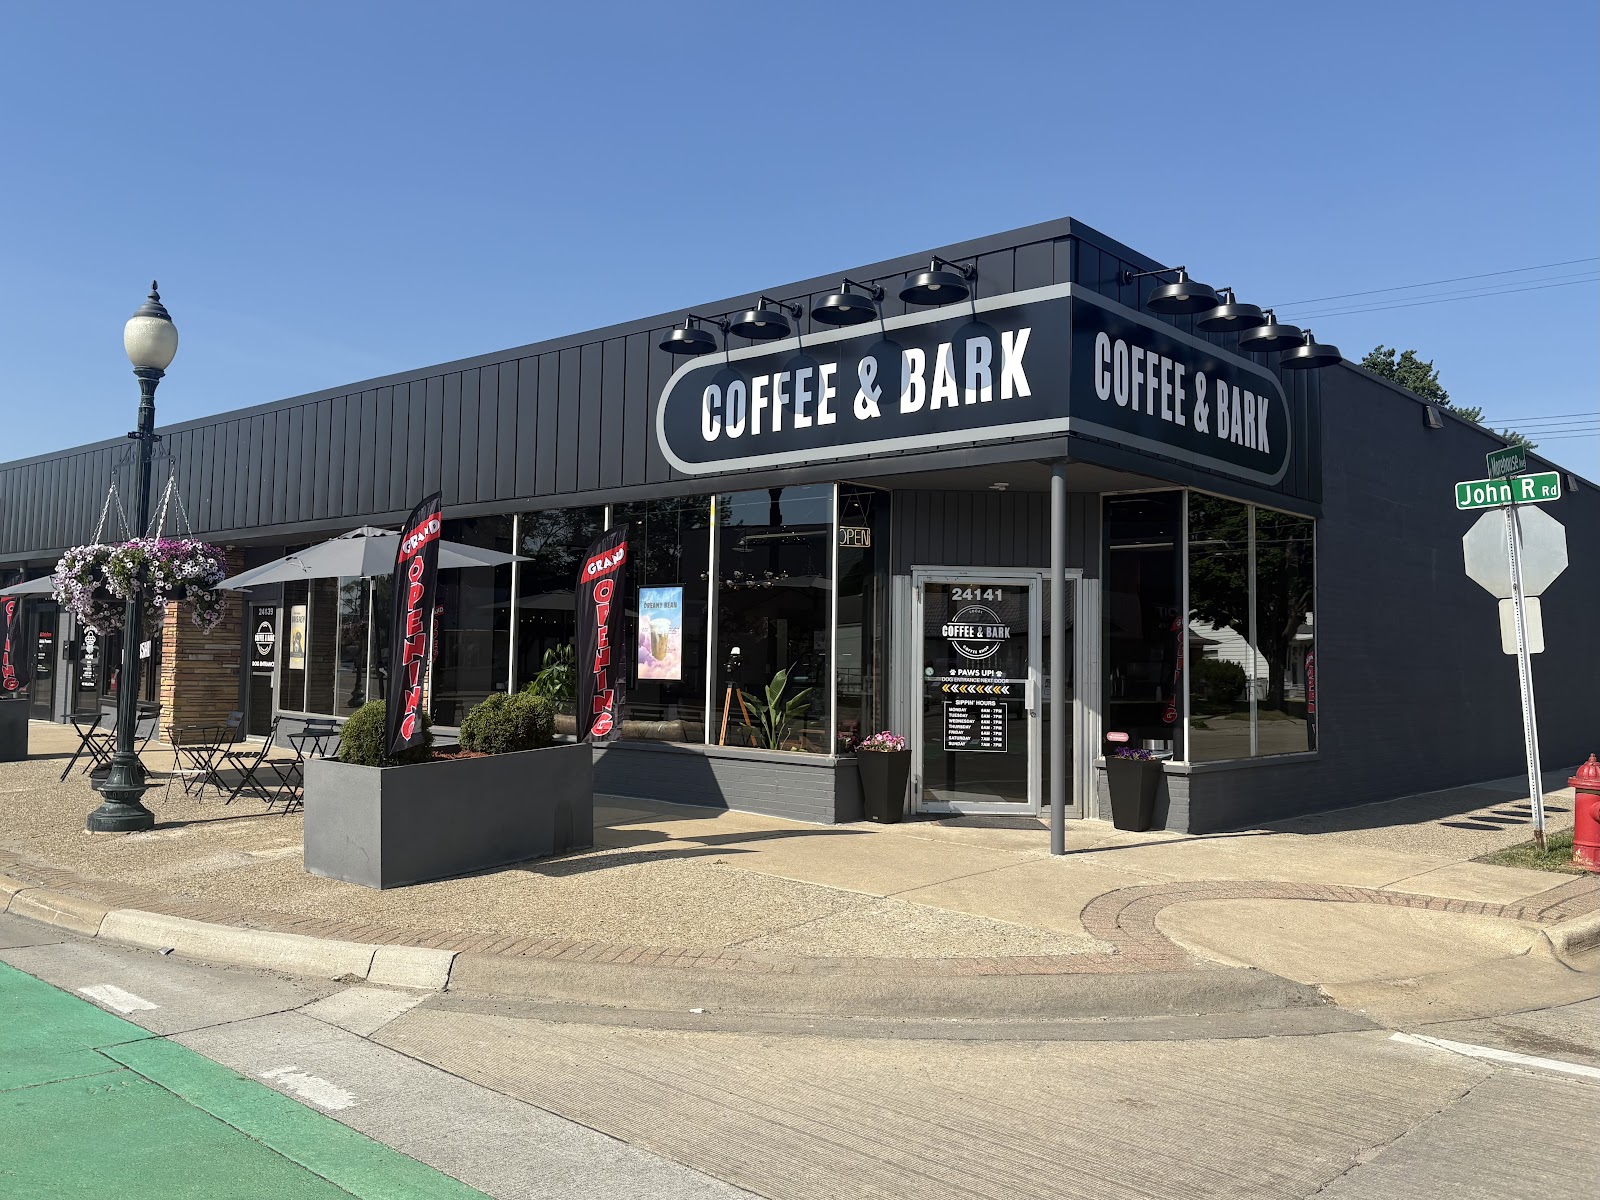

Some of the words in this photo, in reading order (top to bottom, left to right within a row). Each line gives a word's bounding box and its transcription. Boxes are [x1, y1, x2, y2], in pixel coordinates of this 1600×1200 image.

[702, 362, 837, 441] COFFEE
[853, 356, 883, 420] &
[900, 327, 1032, 414] BARK
[1095, 331, 1186, 426] COFFEE
[1194, 371, 1209, 434] &
[1216, 378, 1270, 454] BARK
[1460, 483, 1512, 505] John
[1521, 479, 1535, 498] R
[1542, 485, 1557, 496] Rd
[402, 519, 440, 554] GRAND
[840, 528, 869, 546] OPEN
[587, 547, 625, 576] GRAND
[951, 587, 1002, 601] 24141
[942, 625, 975, 638] COFFEE
[976, 626, 984, 638] &
[986, 626, 1010, 639] BARK
[401, 555, 426, 742] OPENING
[590, 578, 614, 737] OPENING
[957, 669, 980, 677] PAWS
[981, 669, 995, 677] UP!
